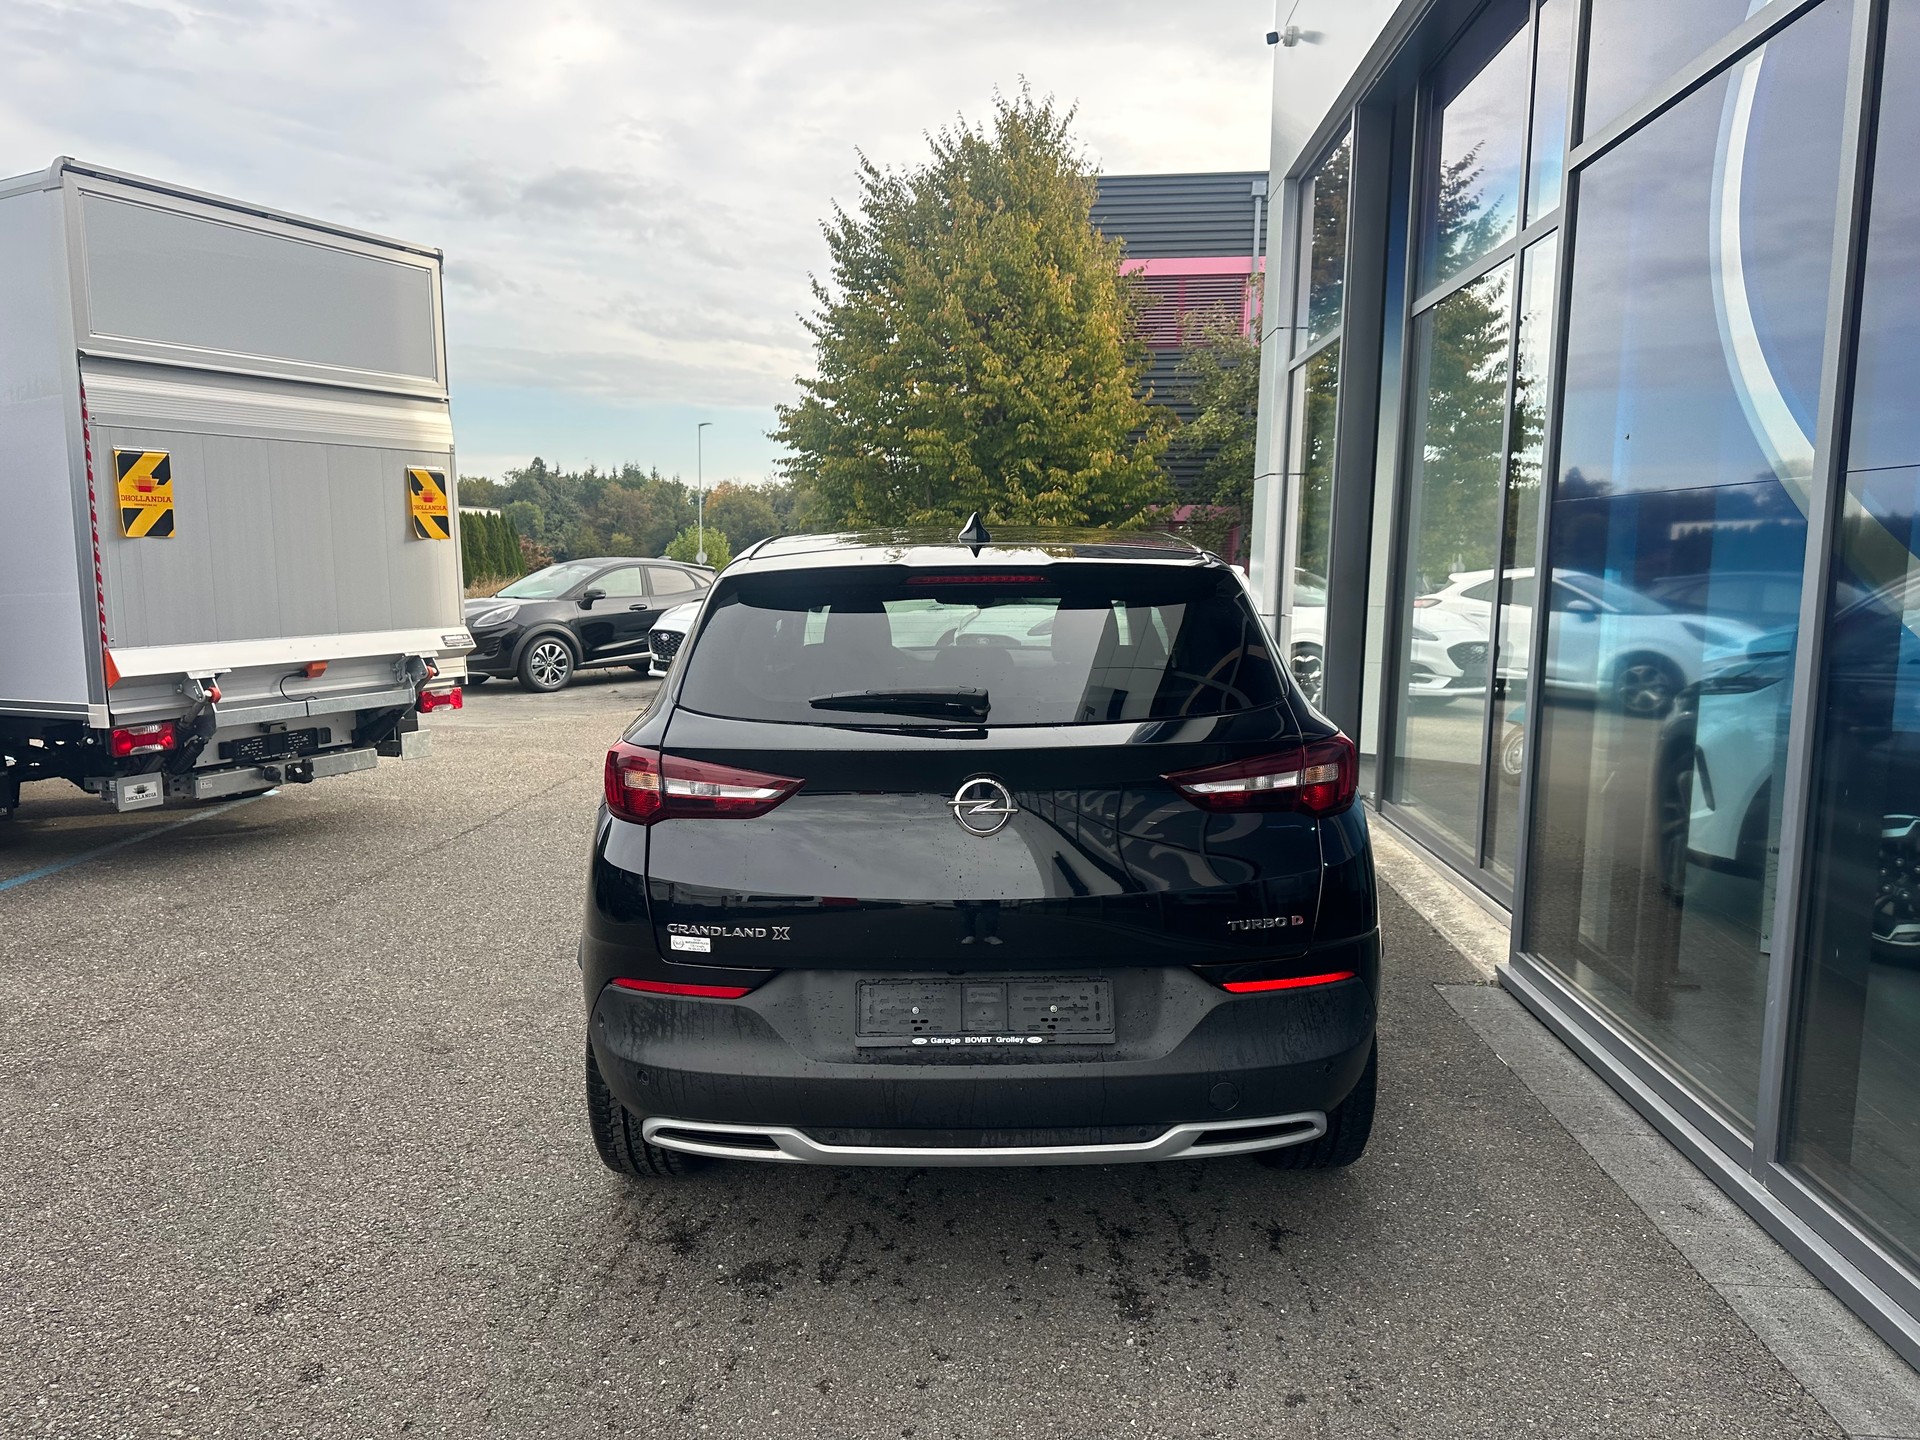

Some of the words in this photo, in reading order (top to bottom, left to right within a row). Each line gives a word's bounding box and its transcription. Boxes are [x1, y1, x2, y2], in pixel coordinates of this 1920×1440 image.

[120, 494, 173, 503] DHOLLANDIA
[1227, 917, 1288, 931] TURBO
[1291, 915, 1304, 926] D
[666, 923, 767, 938] GRANDLAND
[771, 926, 791, 941] X
[930, 1037, 961, 1045] Garage
[964, 1036, 992, 1044] BOVET
[995, 1036, 1024, 1044] Grolley
